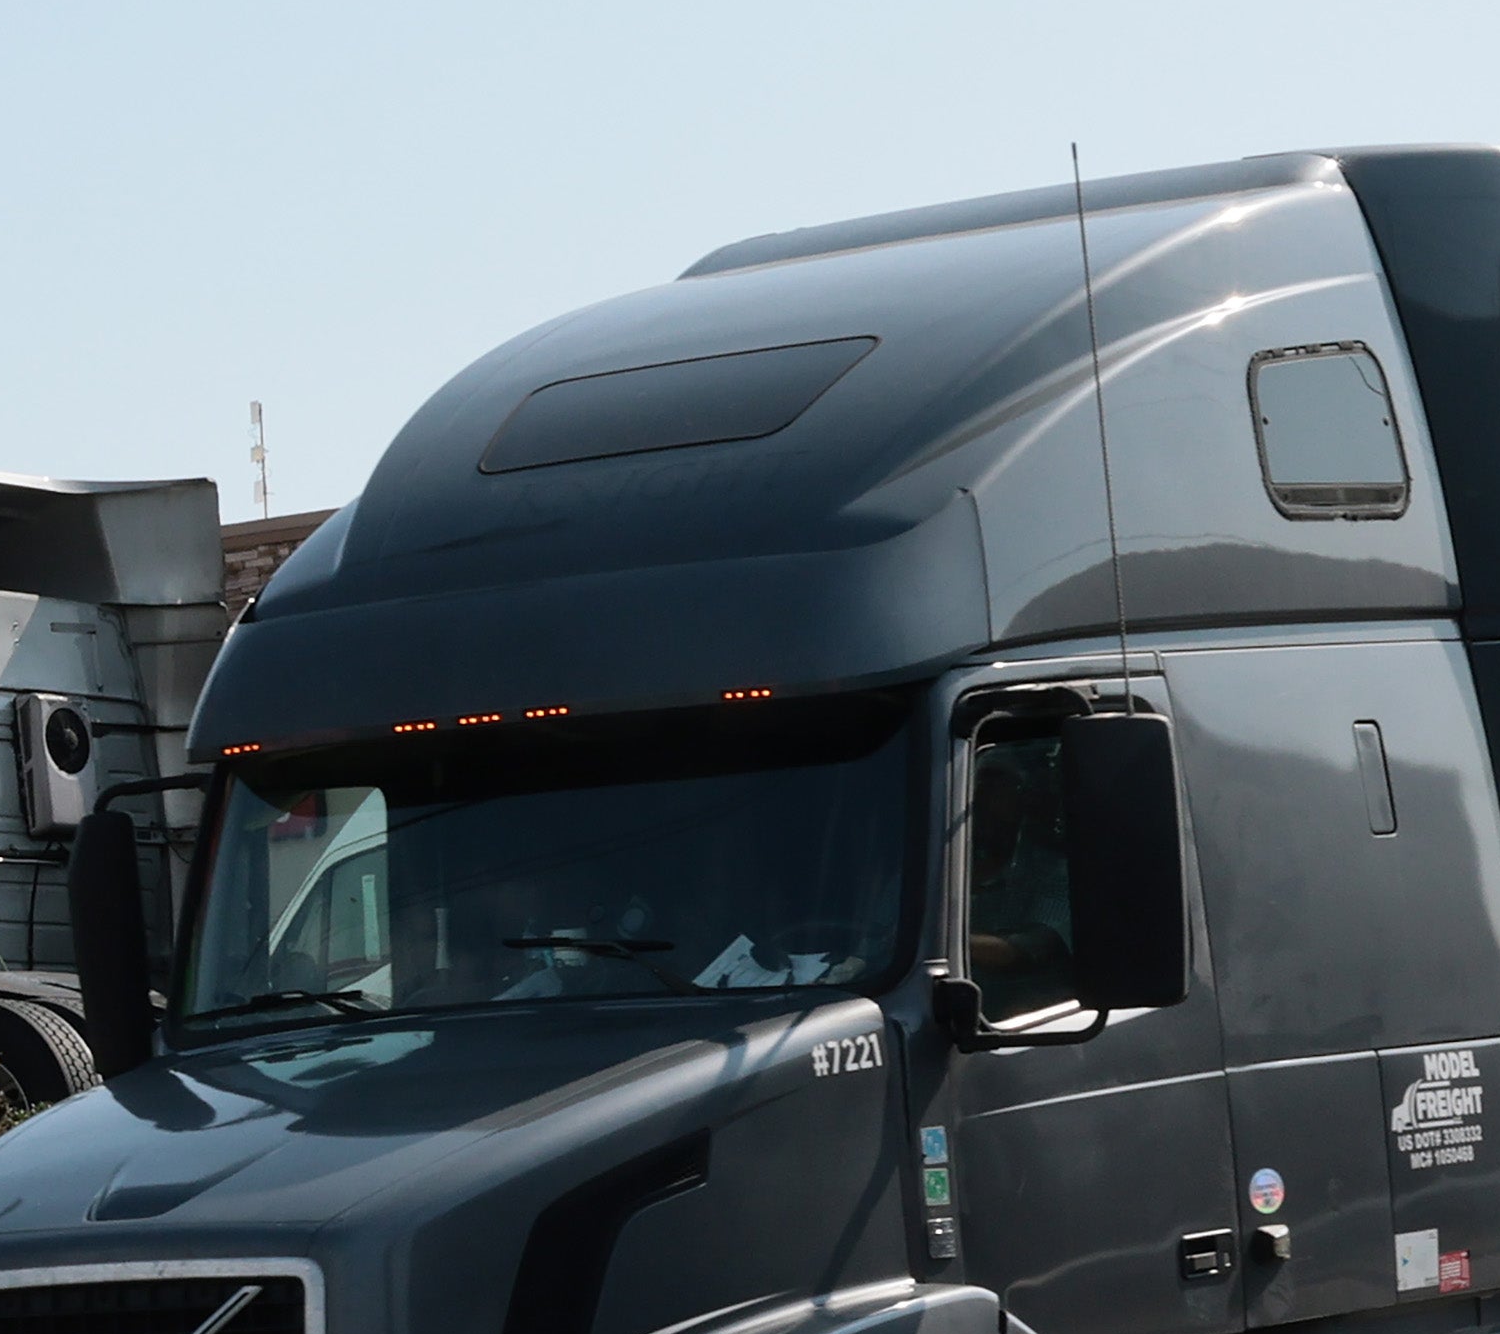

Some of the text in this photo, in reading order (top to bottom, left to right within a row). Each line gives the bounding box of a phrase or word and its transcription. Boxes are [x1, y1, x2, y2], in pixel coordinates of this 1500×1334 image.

[811, 1032, 883, 1078] #7221
[1423, 1050, 1480, 1080] MODEL
[1416, 1086, 1483, 1120] FREIGHT
